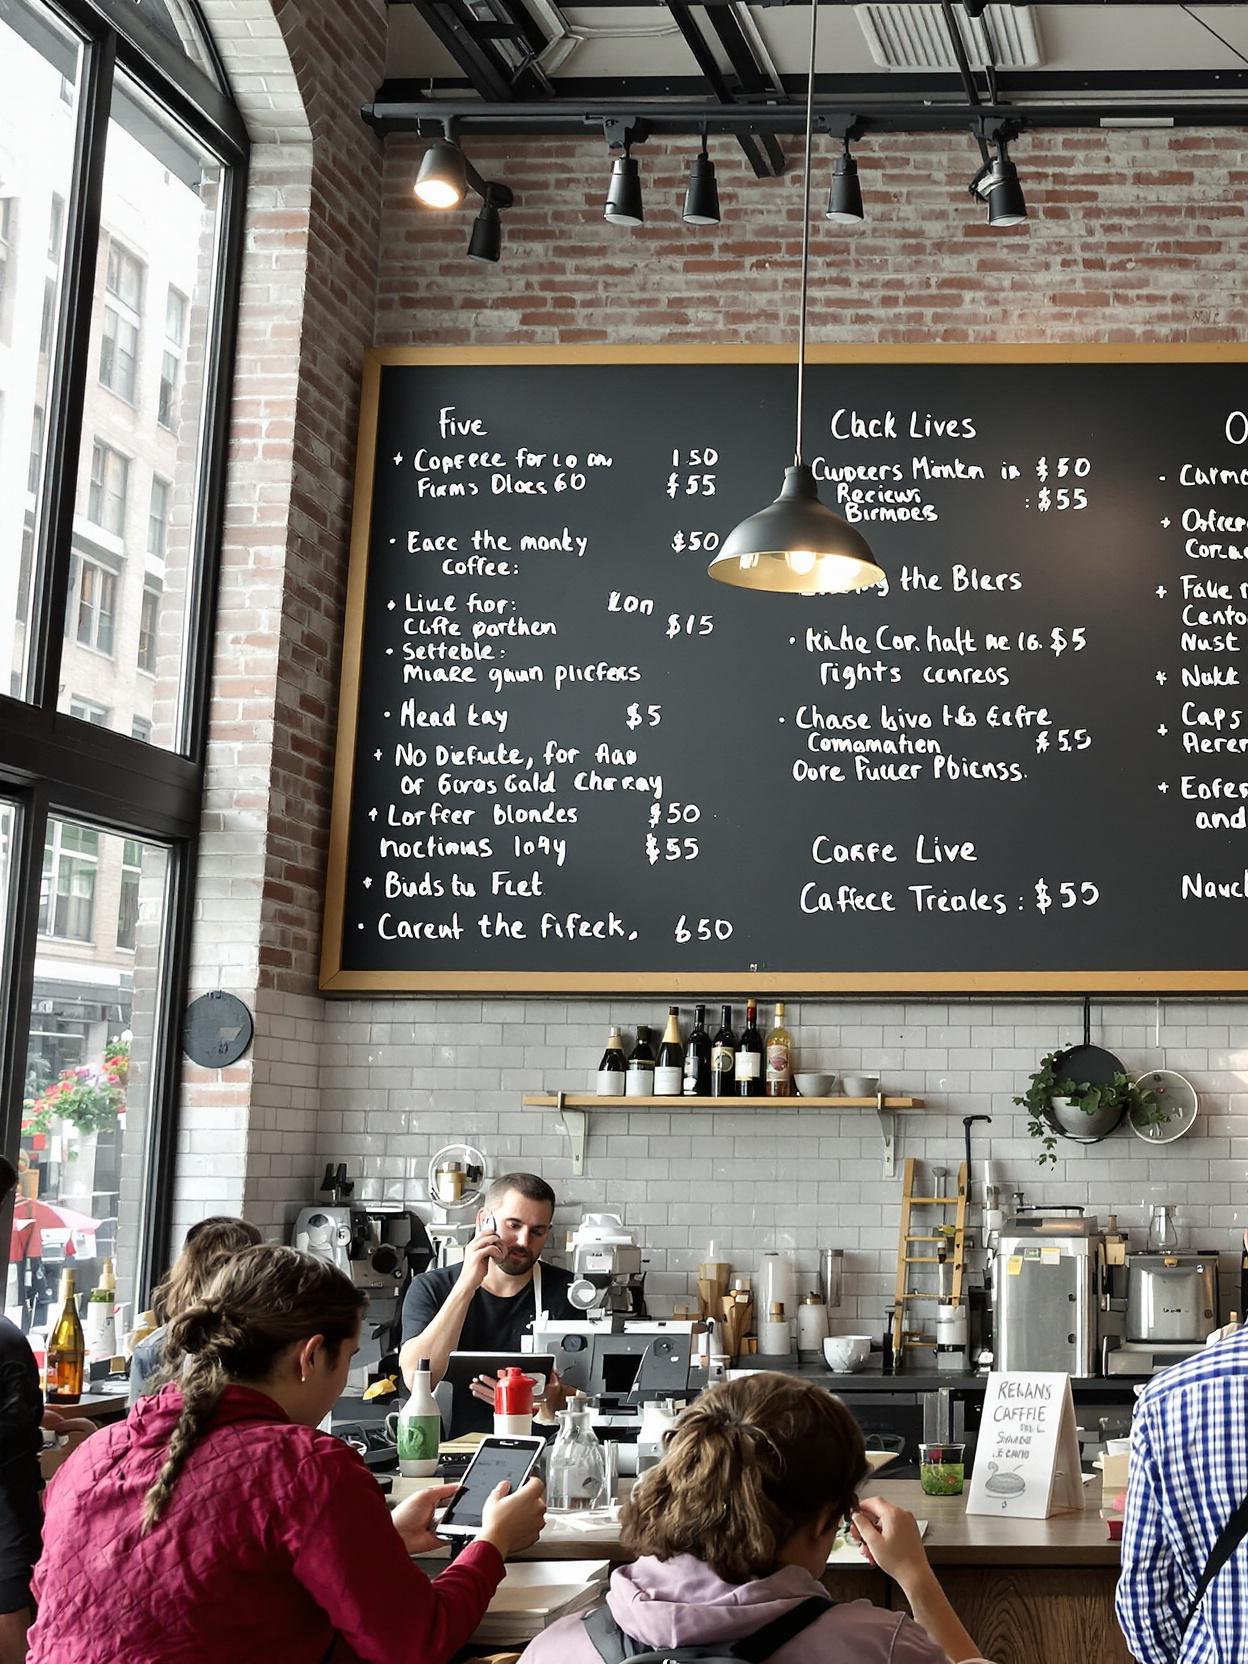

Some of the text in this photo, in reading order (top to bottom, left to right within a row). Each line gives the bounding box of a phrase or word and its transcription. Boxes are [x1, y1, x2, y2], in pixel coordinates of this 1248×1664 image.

[438, 406, 488, 439] Five
[909, 410, 977, 439] Lives
[514, 447, 547, 469] for
[470, 529, 512, 551] the
[671, 529, 720, 554] $50
[899, 565, 943, 592] the
[665, 613, 714, 640] $15
[1049, 626, 1087, 658] $5
[400, 697, 457, 729] Head
[625, 702, 662, 731] $5
[395, 740, 581, 768] No for
[1195, 805, 1247, 830] and
[916, 834, 978, 864] Live
[477, 912, 525, 940] the
